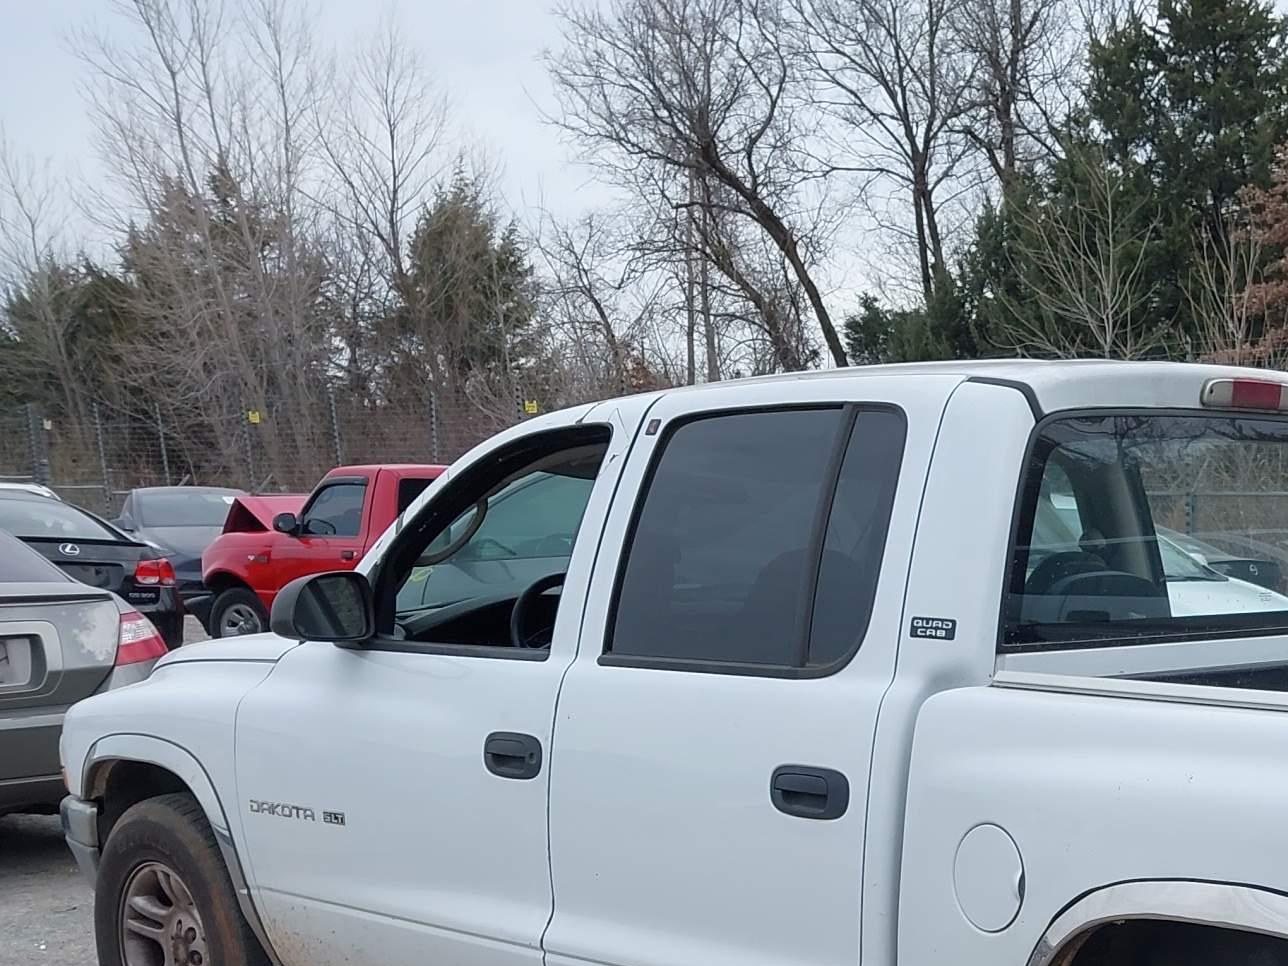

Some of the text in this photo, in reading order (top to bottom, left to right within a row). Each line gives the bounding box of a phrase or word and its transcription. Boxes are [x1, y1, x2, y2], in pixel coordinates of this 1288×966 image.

[913, 619, 952, 629] QUAD
[917, 628, 946, 637] CAB
[249, 799, 316, 822] DAKOTA
[323, 811, 345, 825] SLT
